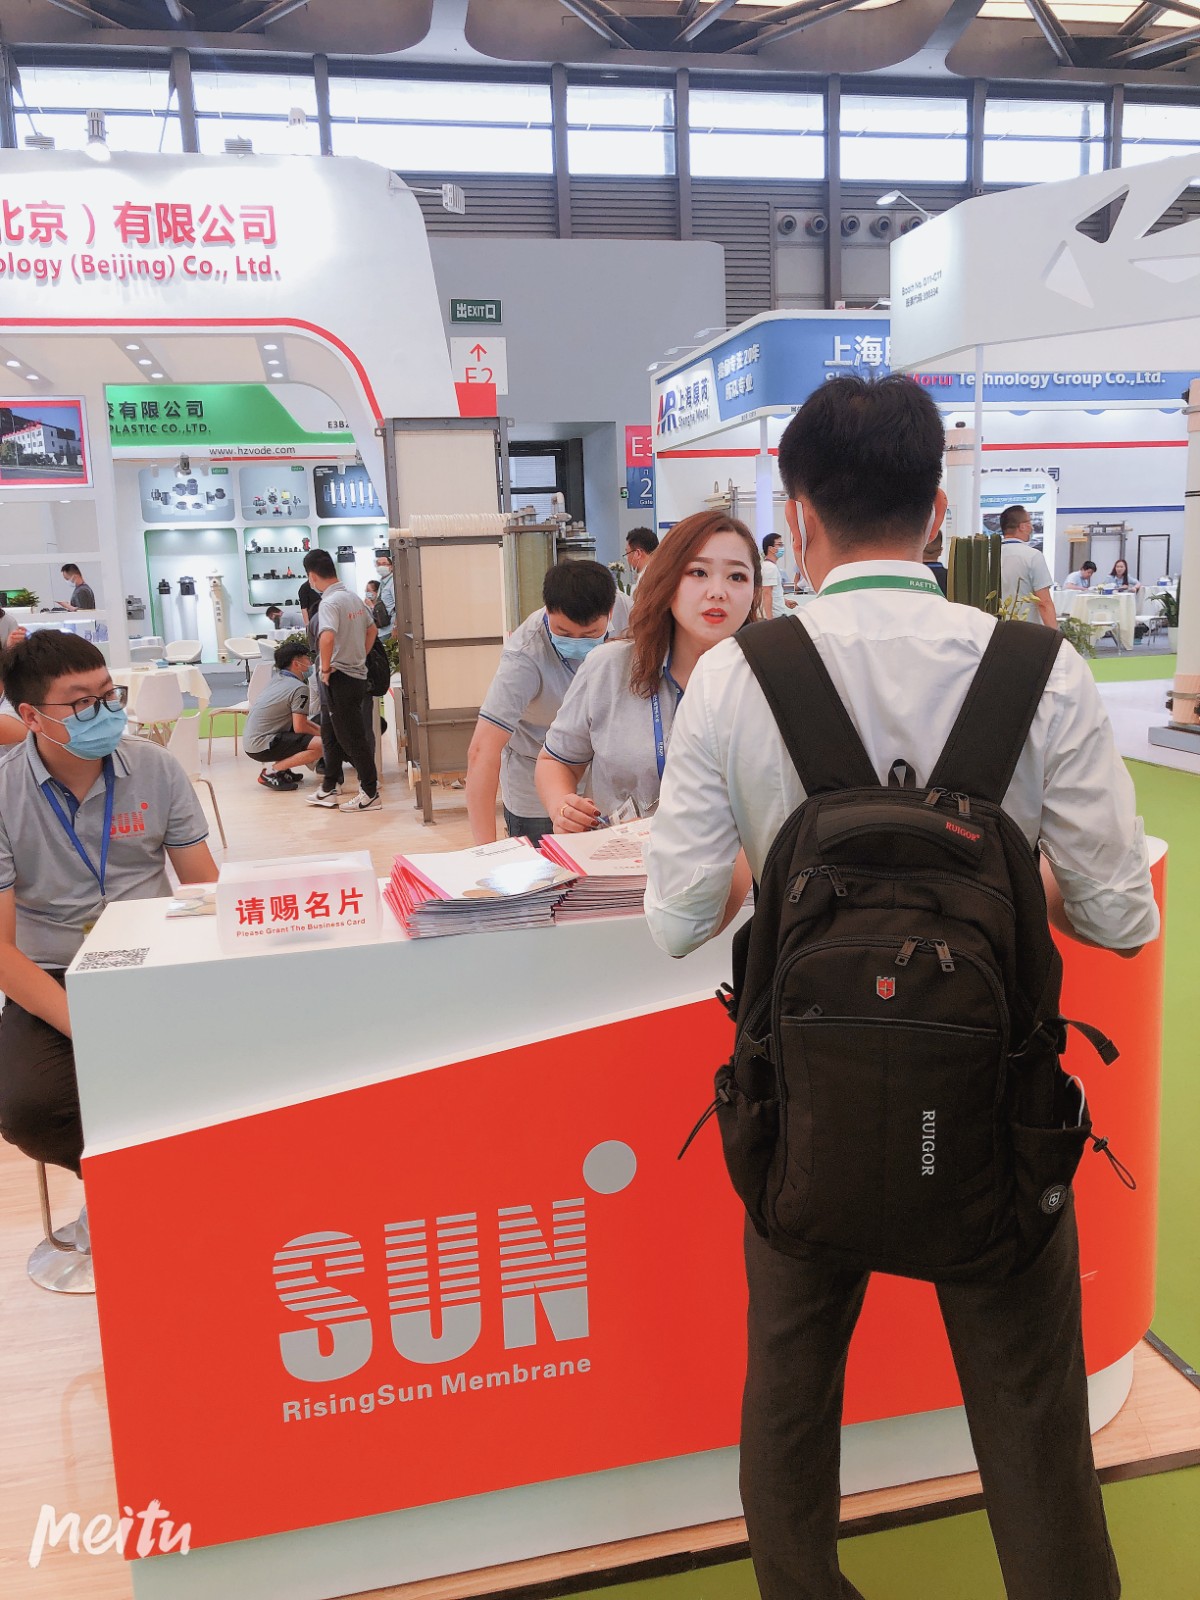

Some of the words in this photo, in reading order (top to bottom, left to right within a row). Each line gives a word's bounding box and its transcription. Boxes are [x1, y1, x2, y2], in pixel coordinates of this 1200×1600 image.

[71, 253, 175, 281] (Beijing)
[183, 255, 228, 278] Co.,
[236, 254, 280, 275] Ltd.
[824, 335, 890, 366] 上海
[959, 372, 1050, 389] Tehnology
[1052, 372, 1102, 388] Group
[1105, 371, 1166, 386] Co.,Ltd.
[161, 423, 211, 434] CO.,LTD.
[209, 446, 296, 455] www.hzvode.com
[640, 478, 652, 498] 2
[235, 887, 364, 926] 请赐名片
[236, 929, 264, 937] Please
[307, 921, 345, 930] Business
[346, 918, 366, 926] Card
[922, 1109, 936, 1176] RUIGOR
[273, 1198, 589, 1382] SUN
[282, 1374, 432, 1423] RisingSun
[441, 1358, 591, 1396] Membrane
